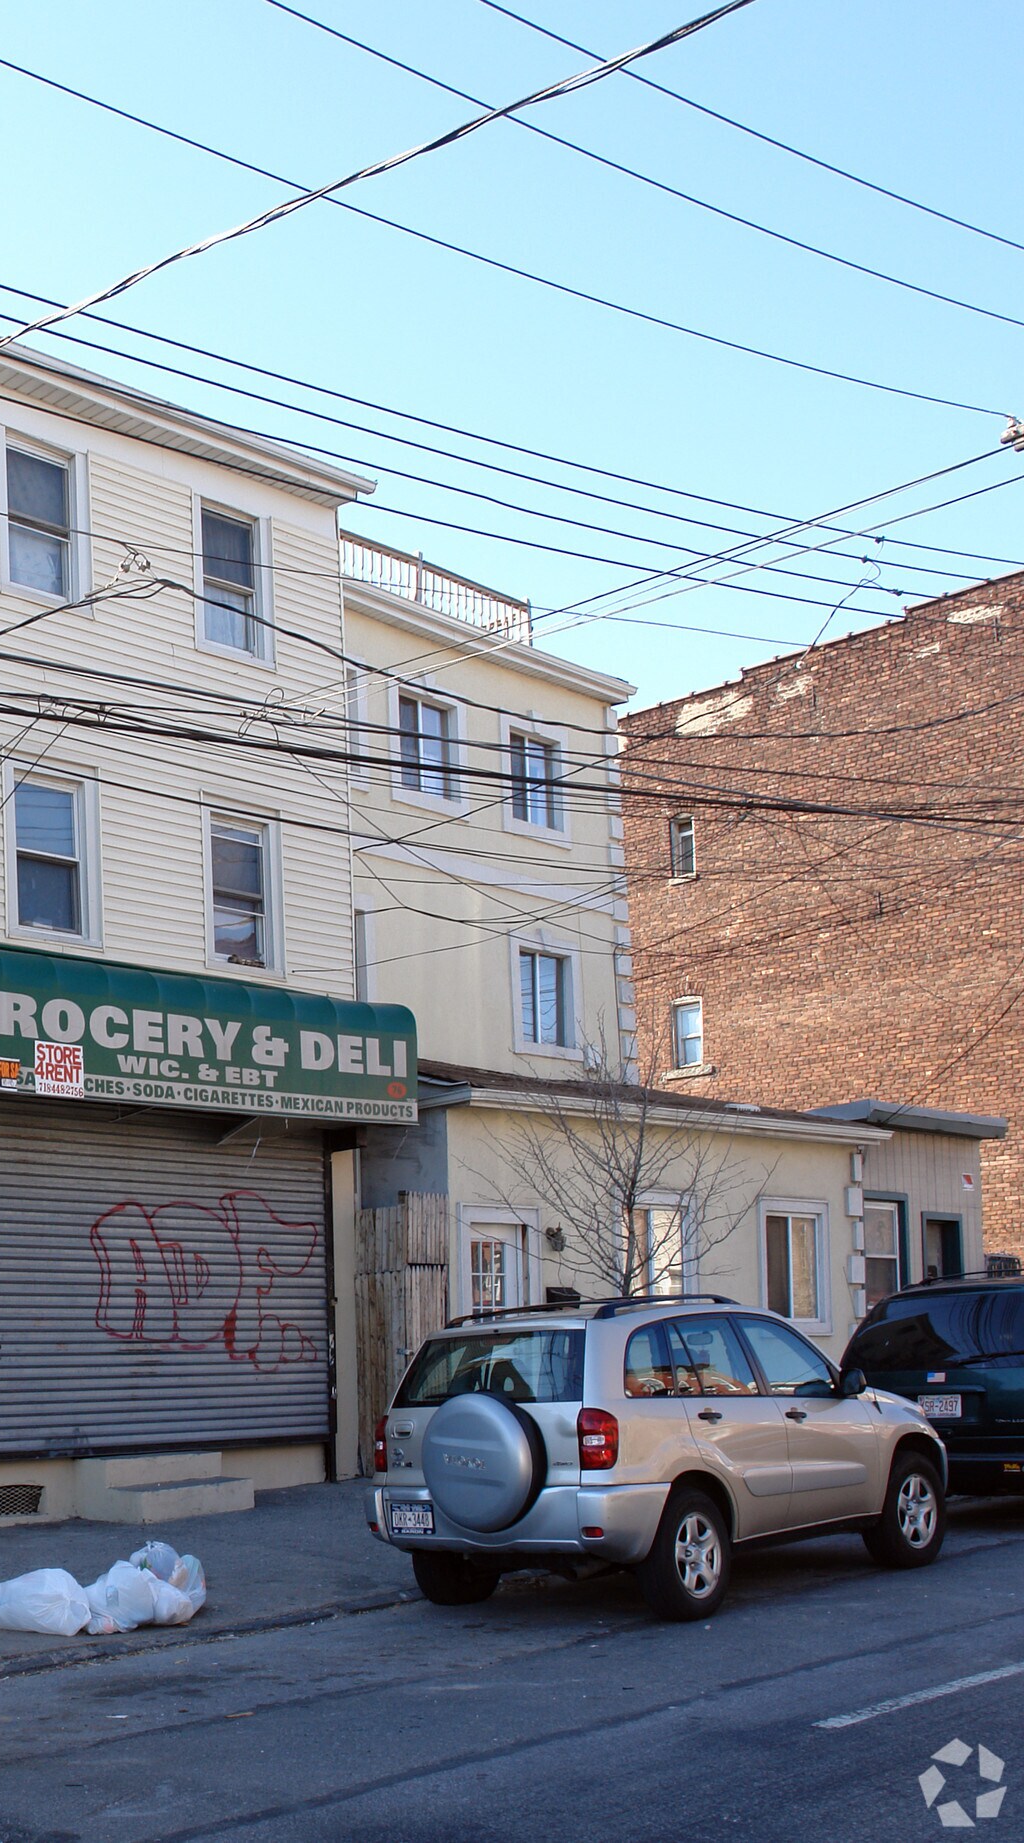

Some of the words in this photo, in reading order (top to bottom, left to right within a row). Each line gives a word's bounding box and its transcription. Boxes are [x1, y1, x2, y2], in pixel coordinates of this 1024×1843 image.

[37, 1043, 81, 1066] STORE
[252, 1025, 289, 1067] &
[300, 1030, 407, 1078] DELI
[10, 1062, 21, 1079] SA
[198, 1064, 219, 1082] &
[225, 1066, 278, 1088] EBT
[133, 1082, 175, 1100] SODA
[183, 1087, 274, 1108] CIGARETTES
[281, 1096, 343, 1114] MEXICAN
[346, 1101, 413, 1118] PRODUCTS
